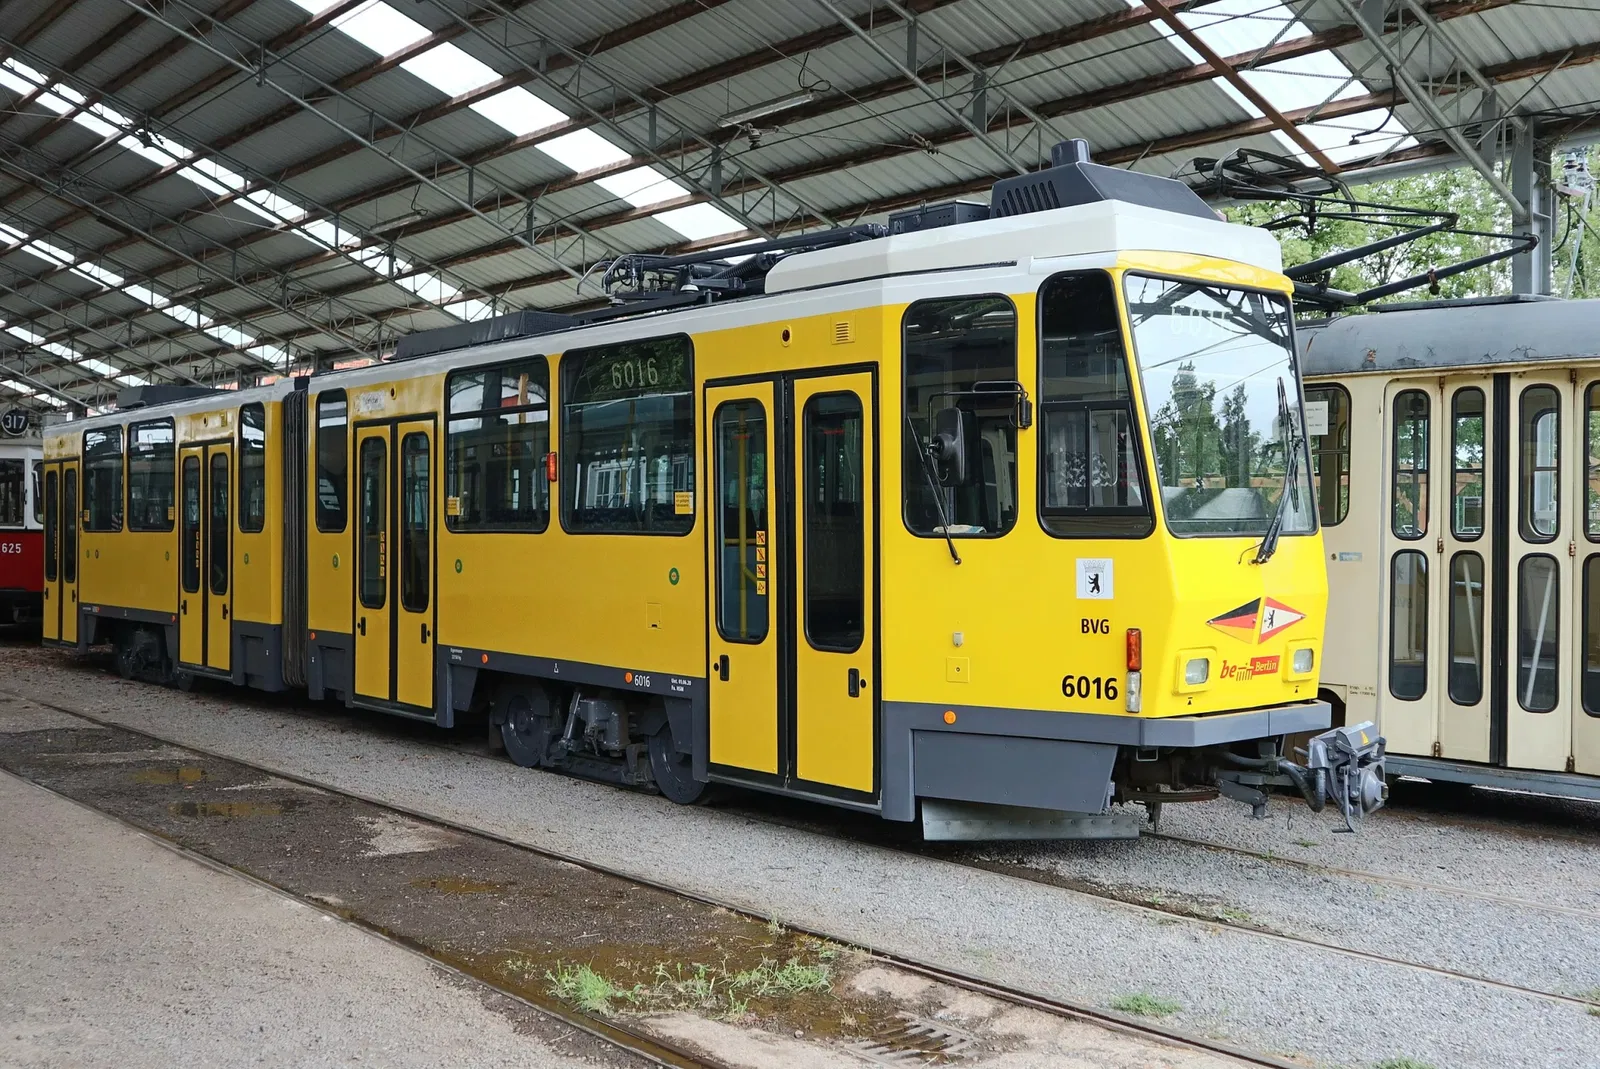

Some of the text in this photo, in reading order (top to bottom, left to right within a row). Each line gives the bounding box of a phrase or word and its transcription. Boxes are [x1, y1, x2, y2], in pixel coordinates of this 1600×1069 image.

[611, 357, 659, 389] 6016
[5, 414, 25, 429] 317
[1, 542, 22, 554] 625
[1081, 618, 1110, 634] BVG
[1220, 660, 1277, 679] be Berlin
[634, 674, 651, 688] 6016
[1062, 674, 1118, 700] 6016
